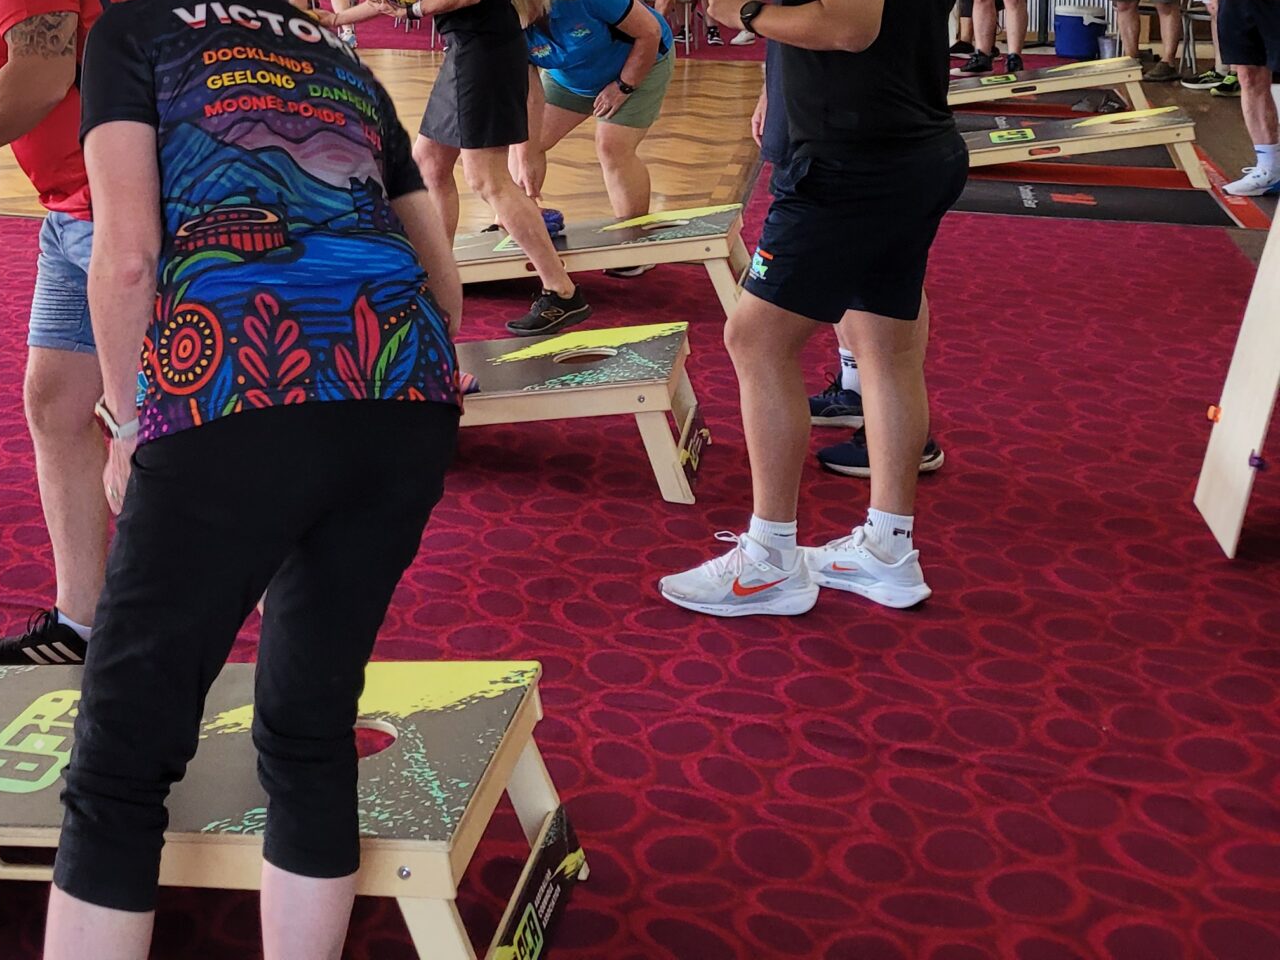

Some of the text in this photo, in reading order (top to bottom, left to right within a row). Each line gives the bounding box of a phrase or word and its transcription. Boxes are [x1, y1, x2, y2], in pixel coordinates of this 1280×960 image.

[203, 46, 314, 74] DOCKLANDS
[206, 71, 296, 90] GEELONG
[204, 95, 346, 127] MOONEE PONDS
